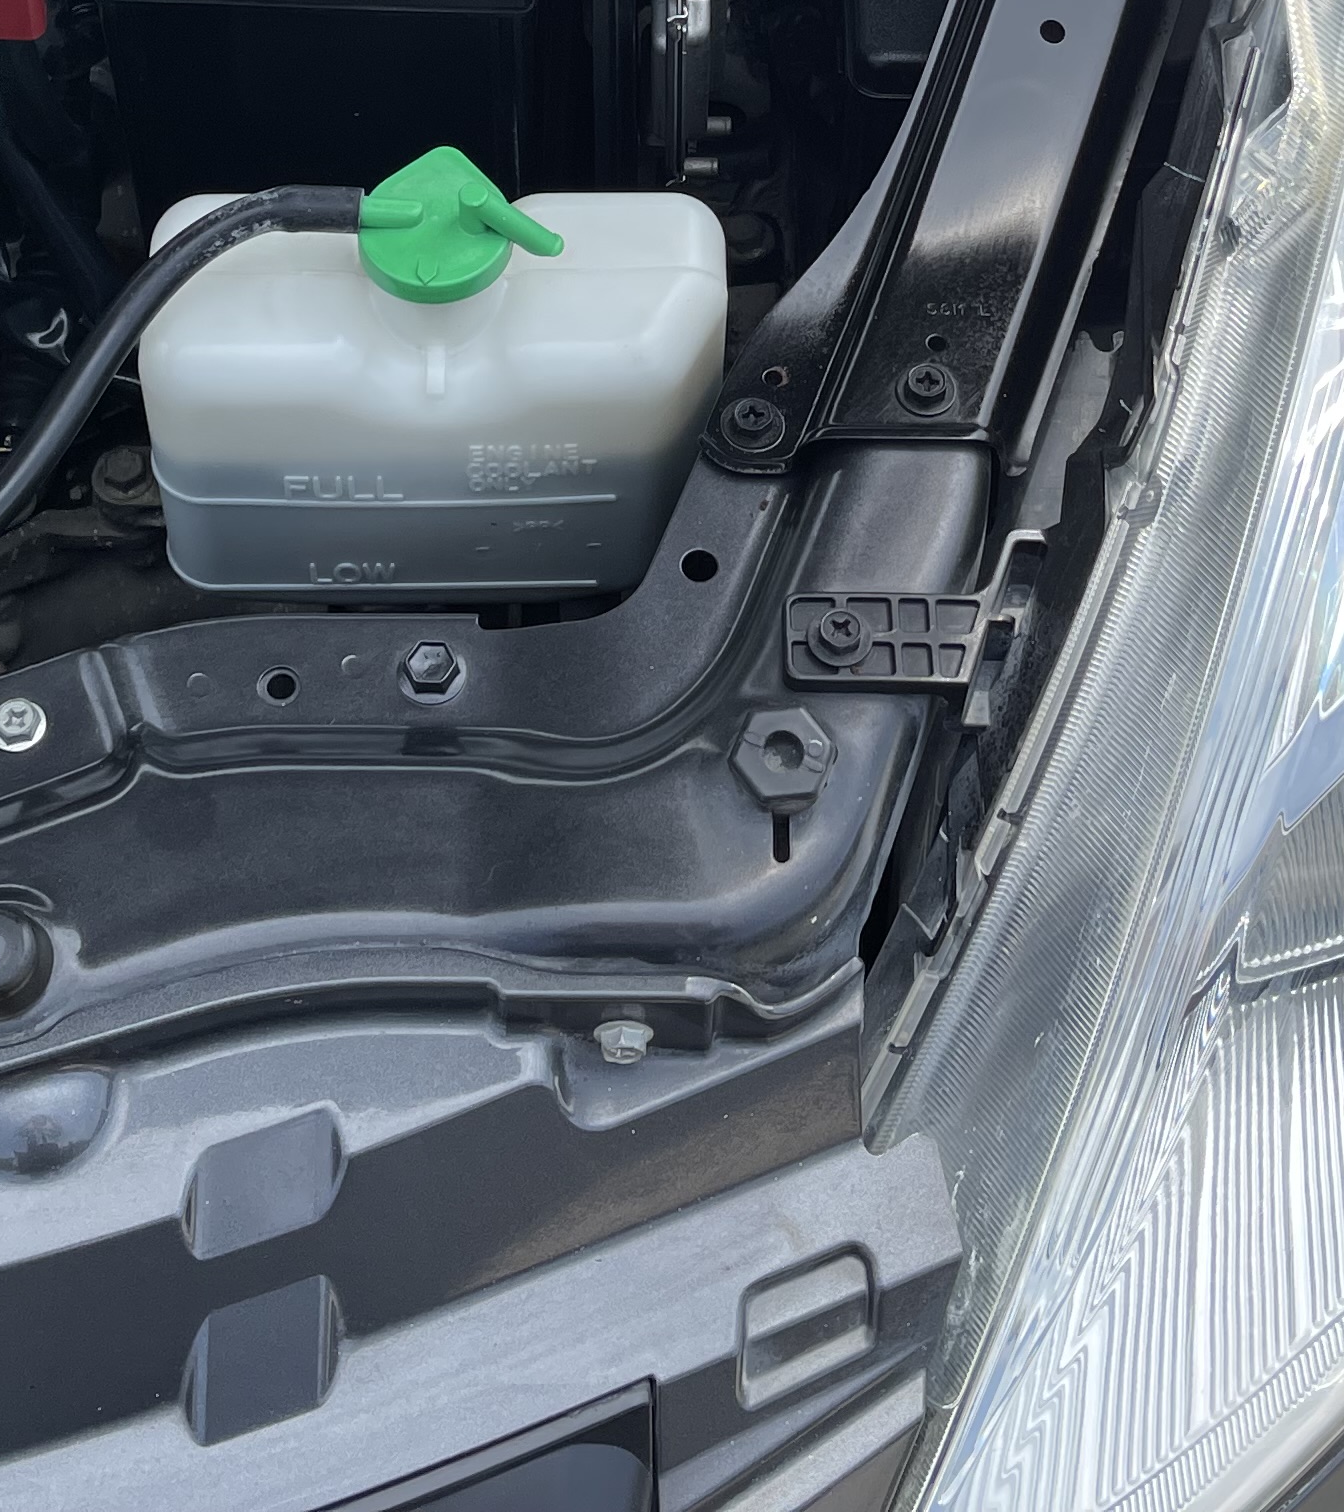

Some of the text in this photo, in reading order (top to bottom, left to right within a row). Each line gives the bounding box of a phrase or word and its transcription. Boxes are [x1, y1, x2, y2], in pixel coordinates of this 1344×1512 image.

[468, 443, 579, 461] ENGINE
[466, 459, 598, 478] COOLANT
[283, 474, 405, 500] FULL
[308, 562, 397, 584] LOW
